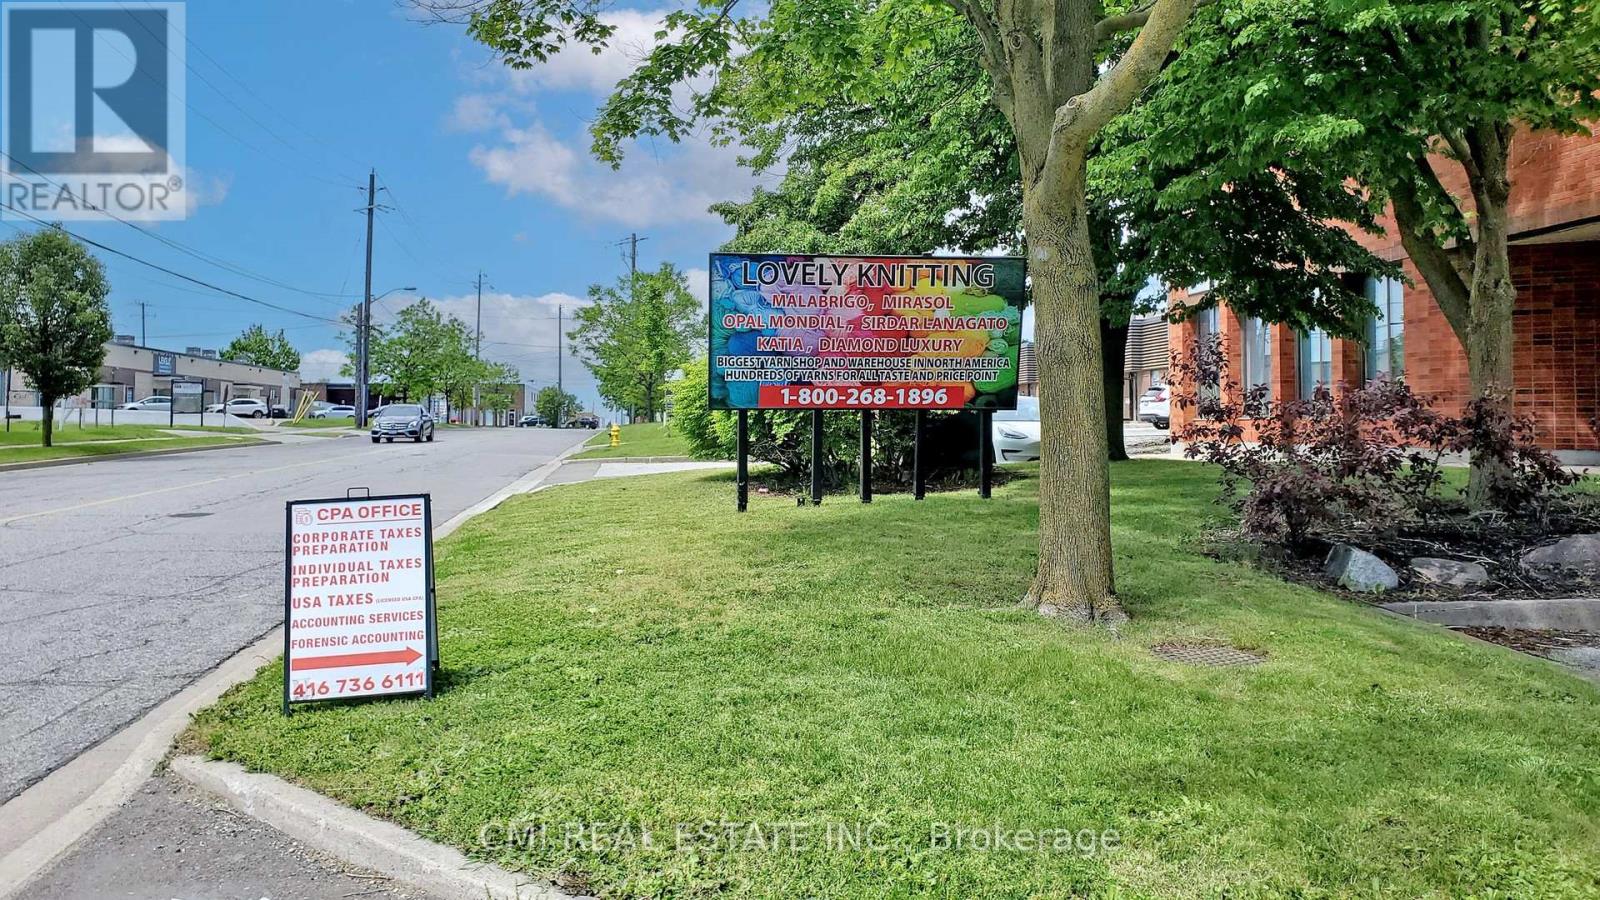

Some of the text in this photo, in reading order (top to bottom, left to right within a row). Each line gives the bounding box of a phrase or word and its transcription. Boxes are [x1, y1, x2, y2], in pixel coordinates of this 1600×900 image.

[741, 261, 996, 288] LOVELY KNITTING
[772, 294, 954, 311] MALABRIGO, MIRASOL
[723, 314, 765, 329] OPAL
[861, 316, 919, 330] SIRDAR
[923, 317, 1008, 331] LANAGATO
[818, 338, 898, 352] DIAMOND
[901, 339, 963, 352] LUXURY
[717, 356, 1010, 369] BIGGEST YARN SHOP AND WAREHOUSE IN NORTH AMERICA
[725, 369, 999, 382] HUNDREDS OF YARNS FOR ALL TASTE AND PRICE POINT
[780, 388, 948, 405] 1-800-268-1896
[317, 503, 422, 521] CPA OFFICE
[293, 527, 422, 544] CORPORATE TAXES
[292, 541, 389, 556] PREPARATION
[292, 558, 422, 576] INDIVIDUAL TAXES
[292, 572, 390, 588] PREPARATION
[292, 596, 322, 609] USA
[327, 592, 374, 607] TAXES
[291, 610, 424, 629] ACCOUNTING SERVICES
[291, 630, 424, 649] FORENSIC ACCOUNTING
[293, 671, 424, 697] 416 736 6111
